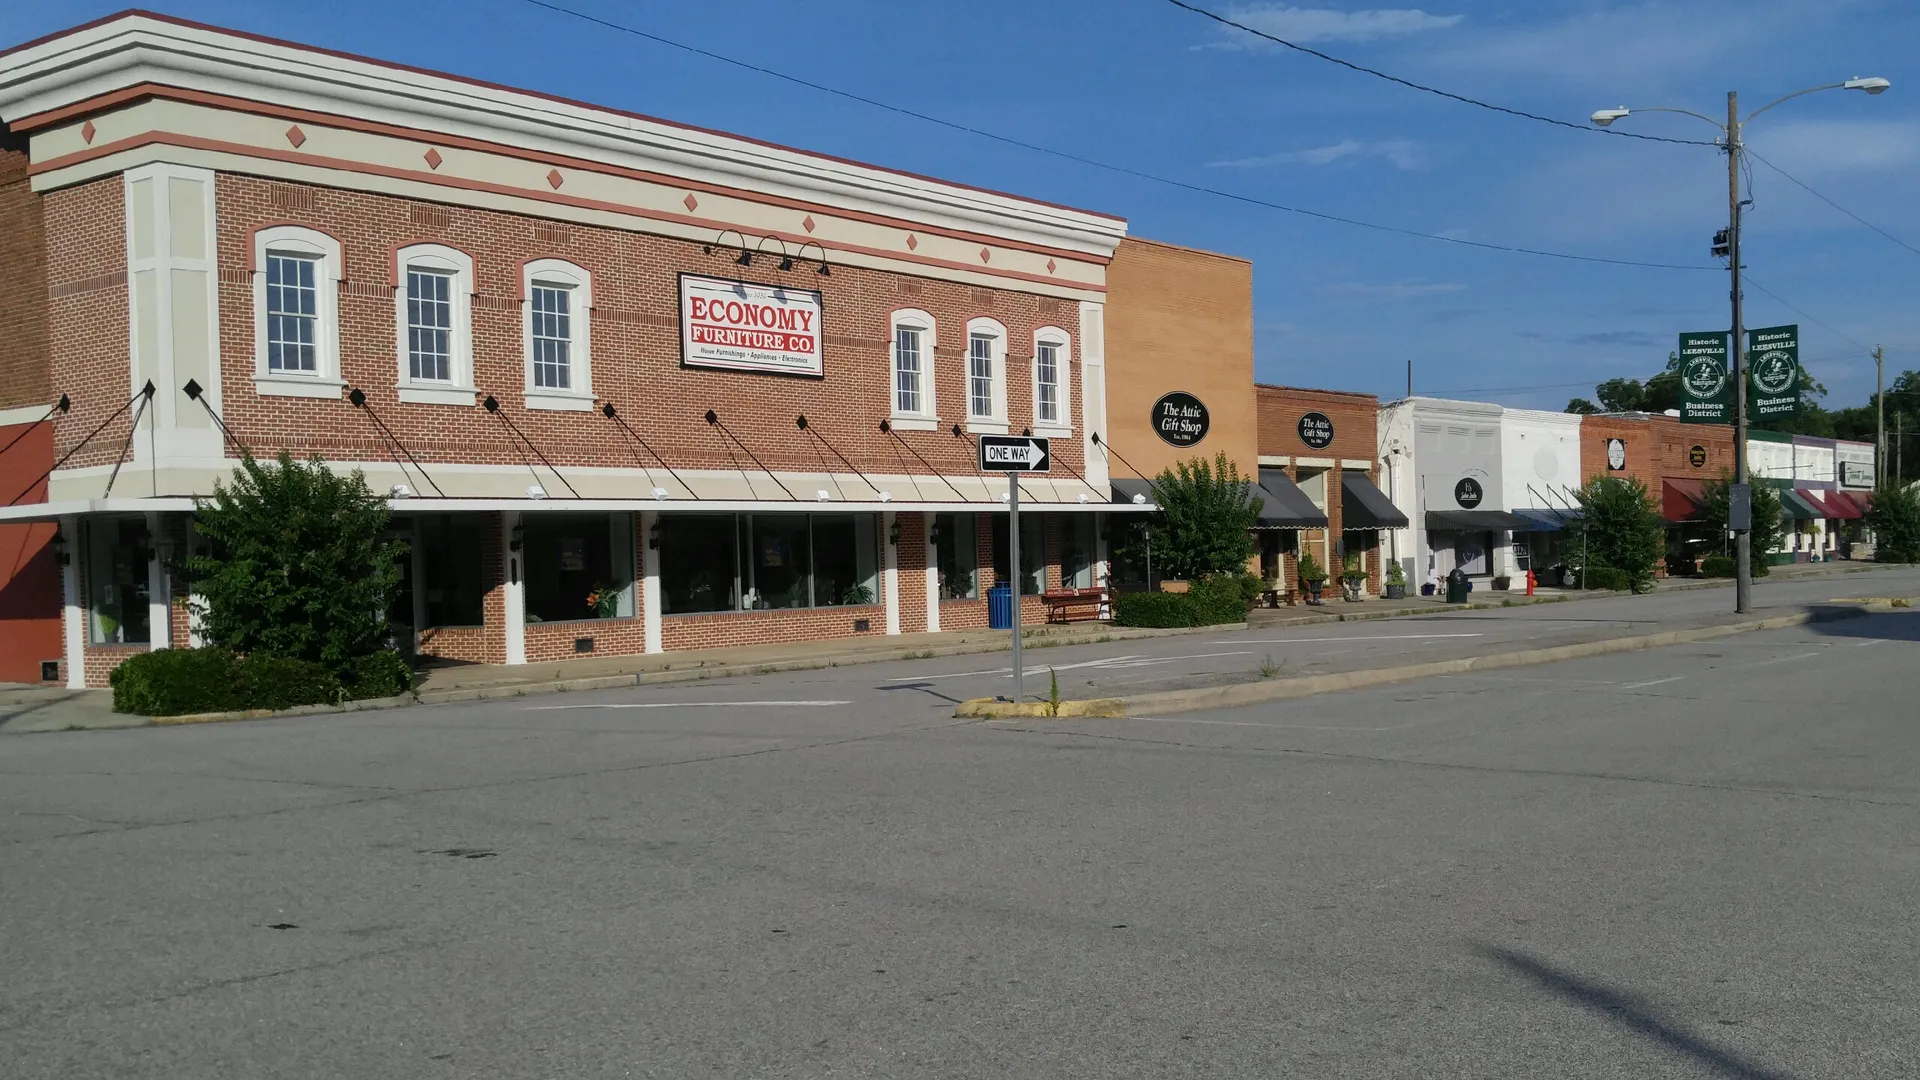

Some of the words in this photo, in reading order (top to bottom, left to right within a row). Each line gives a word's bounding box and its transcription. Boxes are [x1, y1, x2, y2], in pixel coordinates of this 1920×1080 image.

[689, 296, 813, 332] ECONOMY
[692, 325, 785, 350] FURNITURE
[789, 336, 814, 353] CO.
[1758, 332, 1790, 341] Historic
[1752, 341, 1796, 351] LEESVILLE
[700, 347, 715, 355] Home
[716, 348, 746, 359] Furnishings
[750, 351, 777, 361] Appliances
[782, 354, 808, 364] Electronics
[1757, 397, 1795, 406] Business
[1163, 402, 1179, 416] The
[1180, 404, 1202, 418] Attic
[1760, 404, 1793, 413] District
[1161, 417, 1180, 431] Gift
[1180, 419, 1202, 435] Shop
[1303, 418, 1314, 428] The
[1314, 420, 1330, 429] Attic
[1304, 429, 1315, 437] Gift
[1315, 429, 1330, 439] Shop
[989, 447, 1008, 460] ONE
[1011, 447, 1030, 460] WAY
